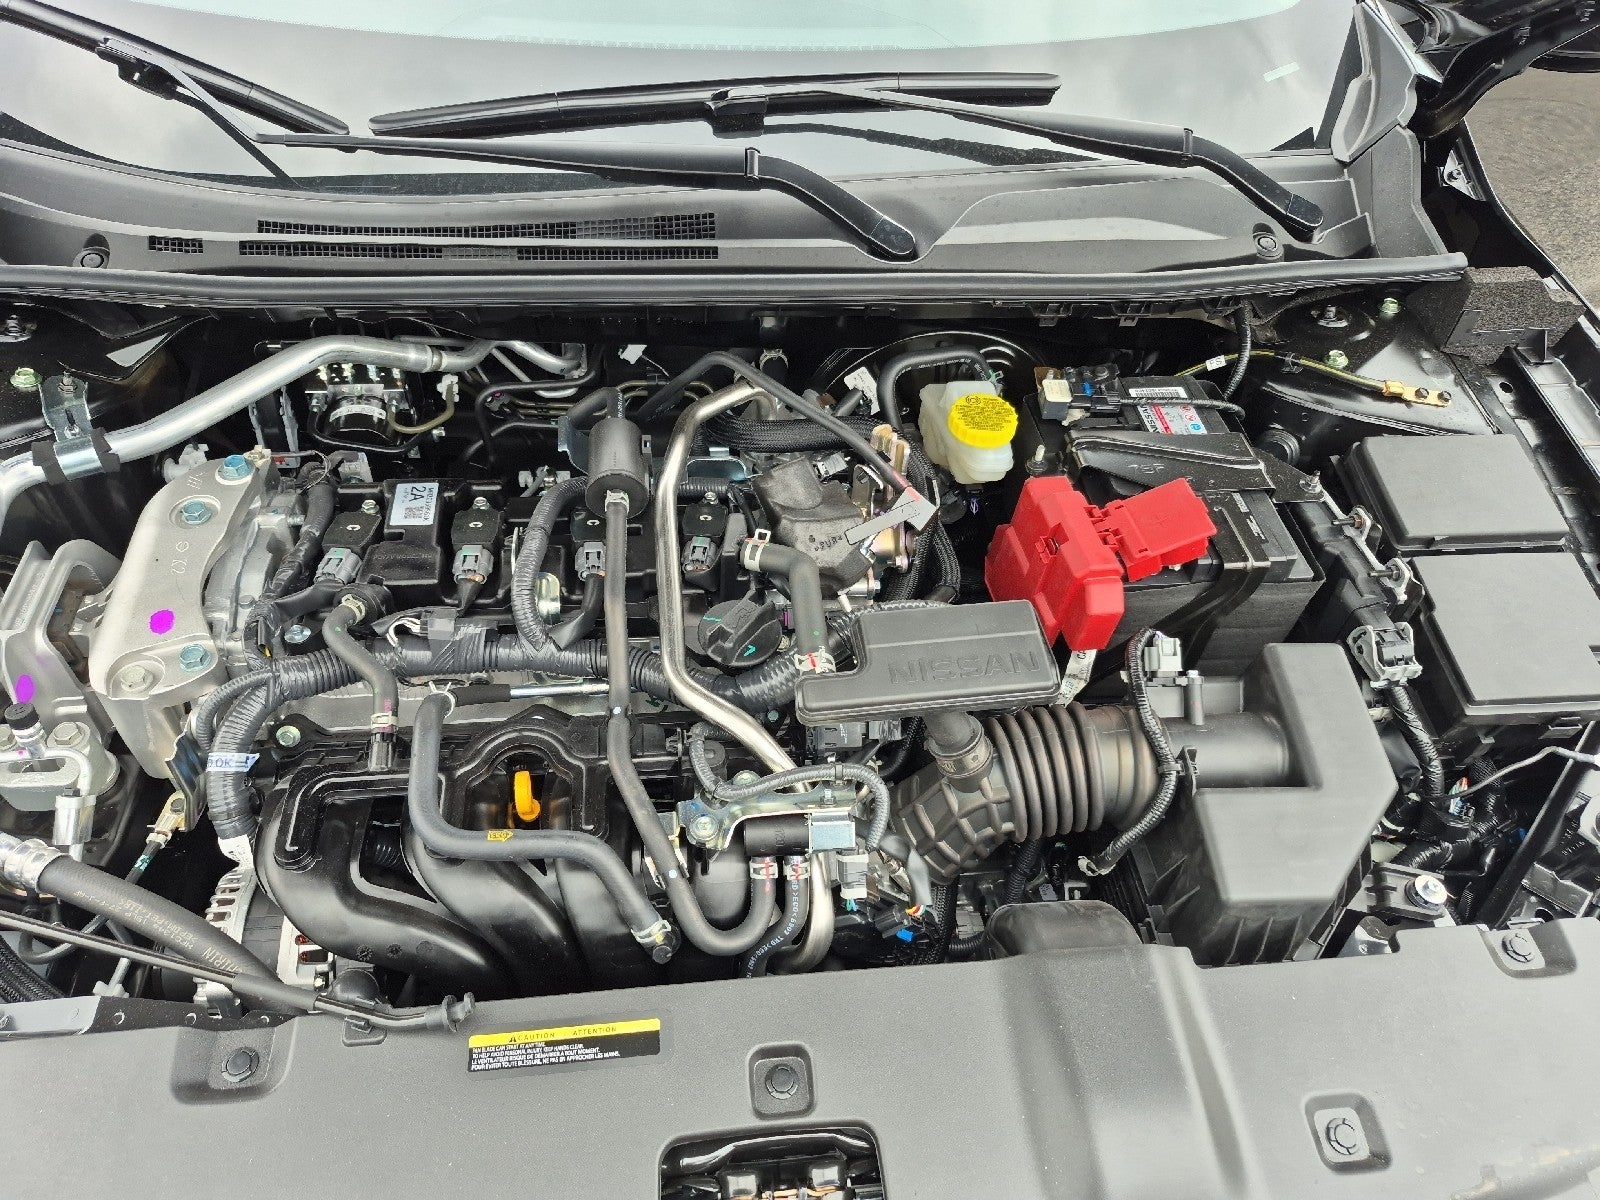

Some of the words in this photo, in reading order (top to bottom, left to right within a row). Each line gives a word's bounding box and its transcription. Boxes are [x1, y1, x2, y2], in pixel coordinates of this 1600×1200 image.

[409, 486, 427, 502] 2A
[888, 651, 1041, 684] NISSAN
[518, 1032, 555, 1040] CAUTION
[573, 1026, 616, 1036] ATTENTION
